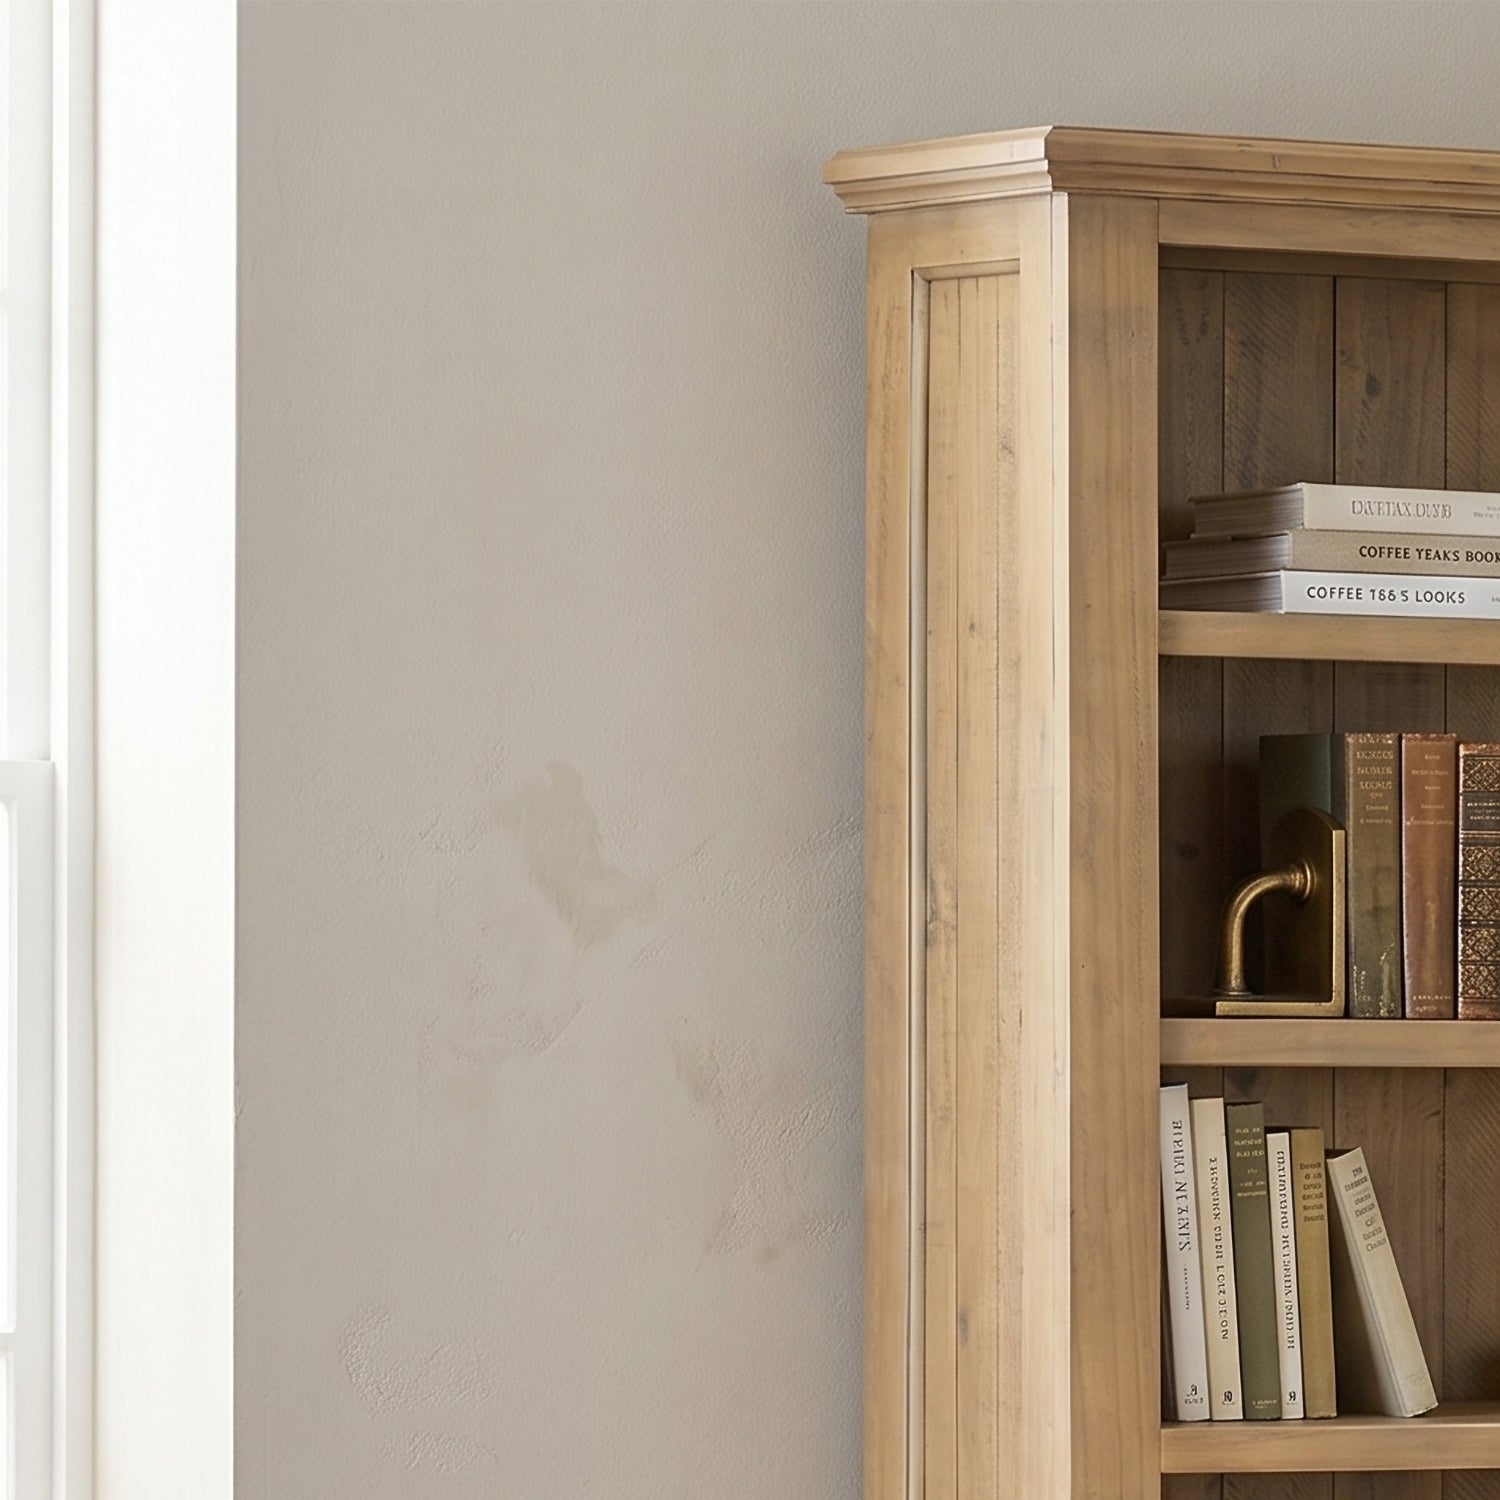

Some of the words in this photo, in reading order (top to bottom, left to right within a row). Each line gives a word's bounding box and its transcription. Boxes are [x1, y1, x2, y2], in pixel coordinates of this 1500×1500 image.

[1358, 545, 1411, 560] COFFEE
[1306, 586, 1363, 600] COFFEE
[1415, 590, 1466, 604] LOOKS
